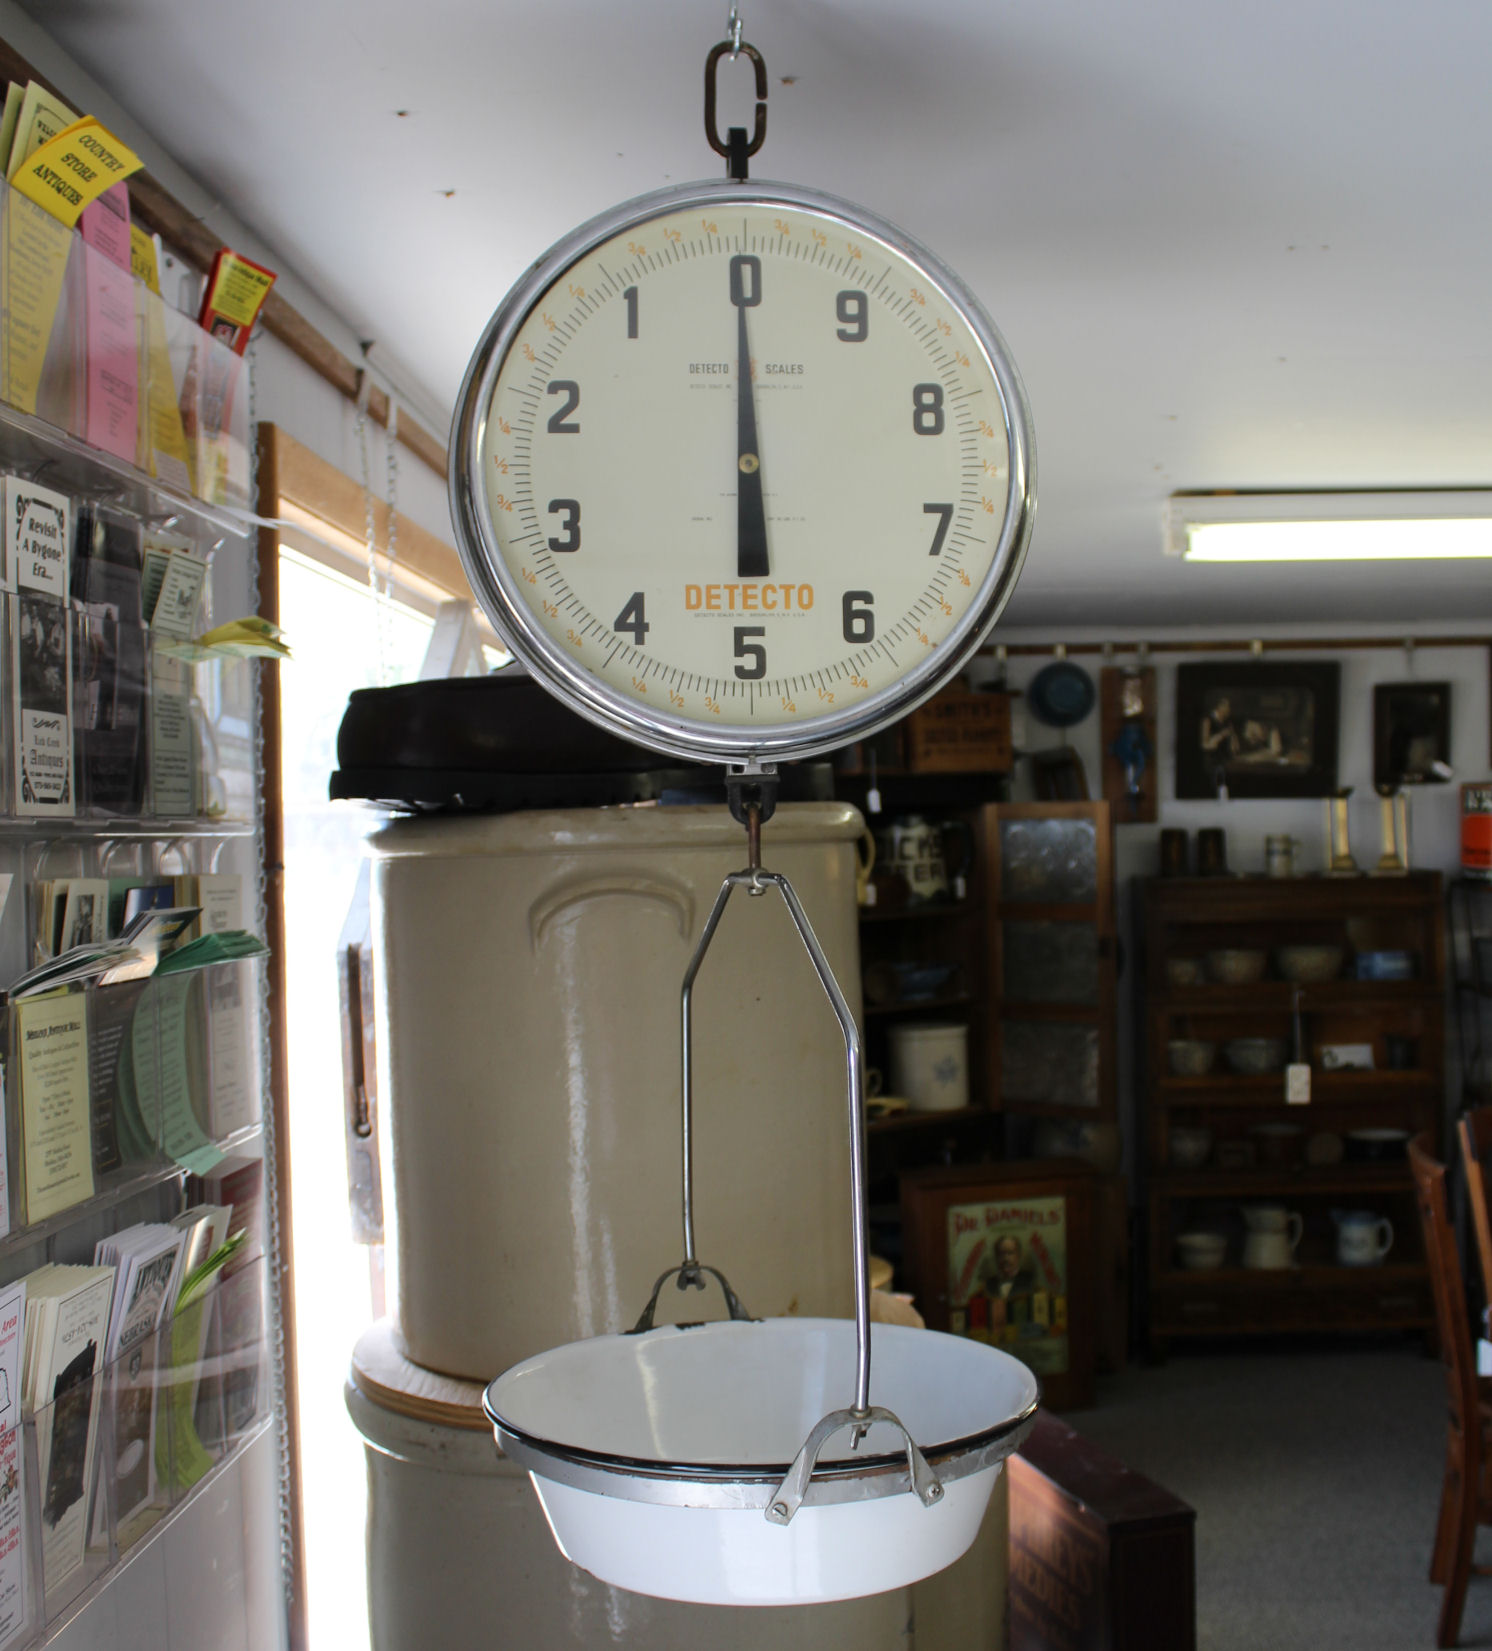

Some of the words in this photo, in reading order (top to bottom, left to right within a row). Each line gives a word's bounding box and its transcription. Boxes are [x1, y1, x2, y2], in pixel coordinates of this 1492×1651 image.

[60, 153, 97, 183] STORE
[78, 134, 125, 173] COUNTRY
[32, 164, 84, 206] ANTIQUES
[730, 255, 762, 307] 0
[623, 286, 639, 339] 1
[836, 290, 869, 342] 9
[689, 363, 729, 374] DETECTO
[765, 363, 804, 375] SCALES
[547, 380, 580, 433] 2
[913, 383, 945, 435] 8
[22, 538, 29, 552] A
[31, 540, 61, 562] Bygone
[28, 517, 58, 539] Revisit
[548, 499, 581, 552] 3
[923, 503, 954, 556] 7
[613, 592, 650, 645] 4
[685, 584, 814, 610] DETECTO
[842, 591, 875, 644] 6
[733, 626, 767, 680] 5
